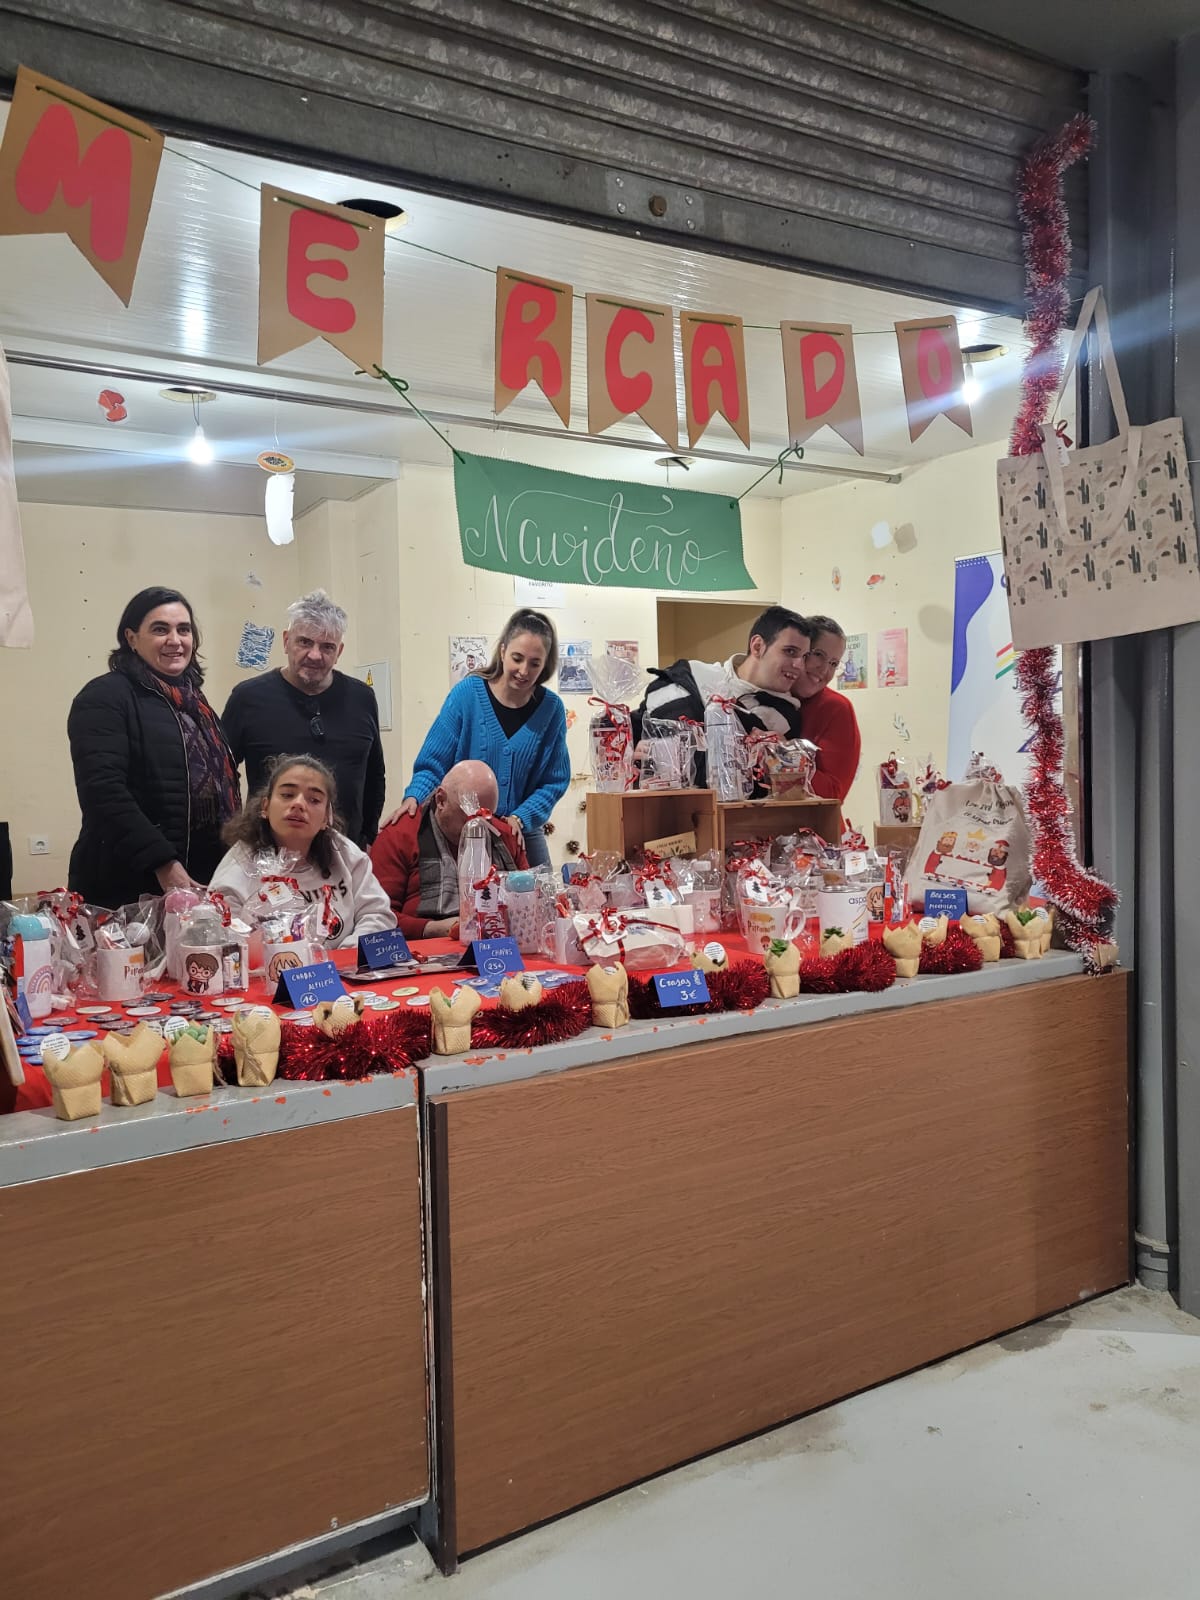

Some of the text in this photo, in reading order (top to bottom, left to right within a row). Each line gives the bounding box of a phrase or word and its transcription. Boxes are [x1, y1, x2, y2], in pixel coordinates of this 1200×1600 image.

[15, 104, 953, 425] MERCADO
[465, 490, 728, 585] Navideño
[680, 989, 698, 1001] 3€
